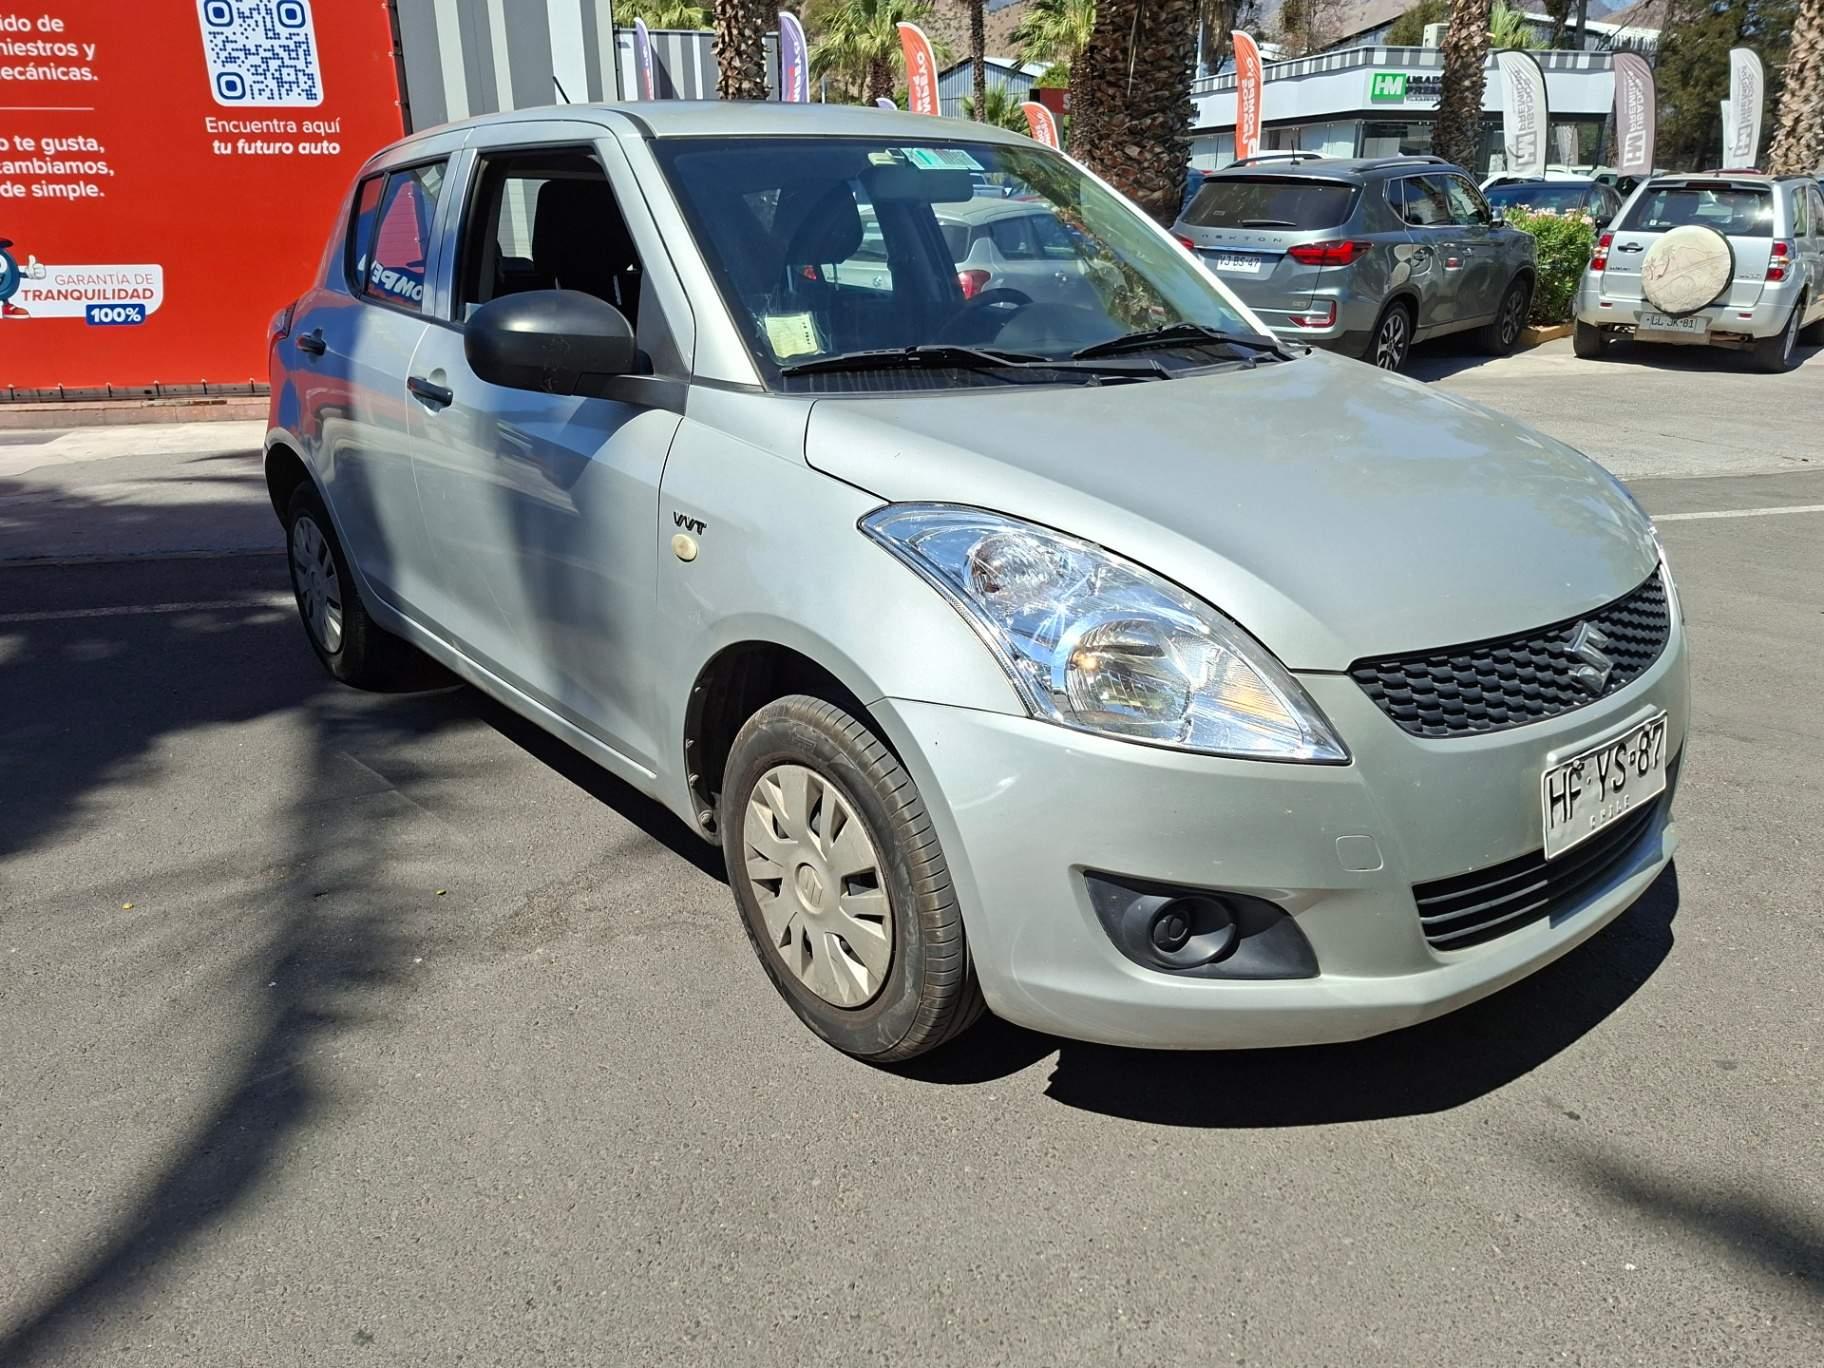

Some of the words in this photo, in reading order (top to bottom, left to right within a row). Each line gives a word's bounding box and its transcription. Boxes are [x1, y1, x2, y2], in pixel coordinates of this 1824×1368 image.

[36, 14, 64, 32] de
[82, 43, 95, 61] y
[1374, 75, 1404, 95] HM
[205, 117, 297, 133] Encuentra
[302, 117, 341, 136] aquí
[13, 135, 35, 151] te
[41, 135, 104, 155] gusta,
[212, 140, 231, 154] tu
[237, 139, 294, 154] futuro
[298, 140, 341, 154] auto
[0, 157, 114, 176] ambiamos,
[0, 180, 26, 197] de
[31, 180, 104, 201] simple.
[55, 272, 131, 286] GARANTÍA
[134, 273, 154, 285] DE
[21, 288, 154, 301] TRANQUILIDAD
[90, 307, 141, 323] 100%
[673, 511, 707, 536] VVT
